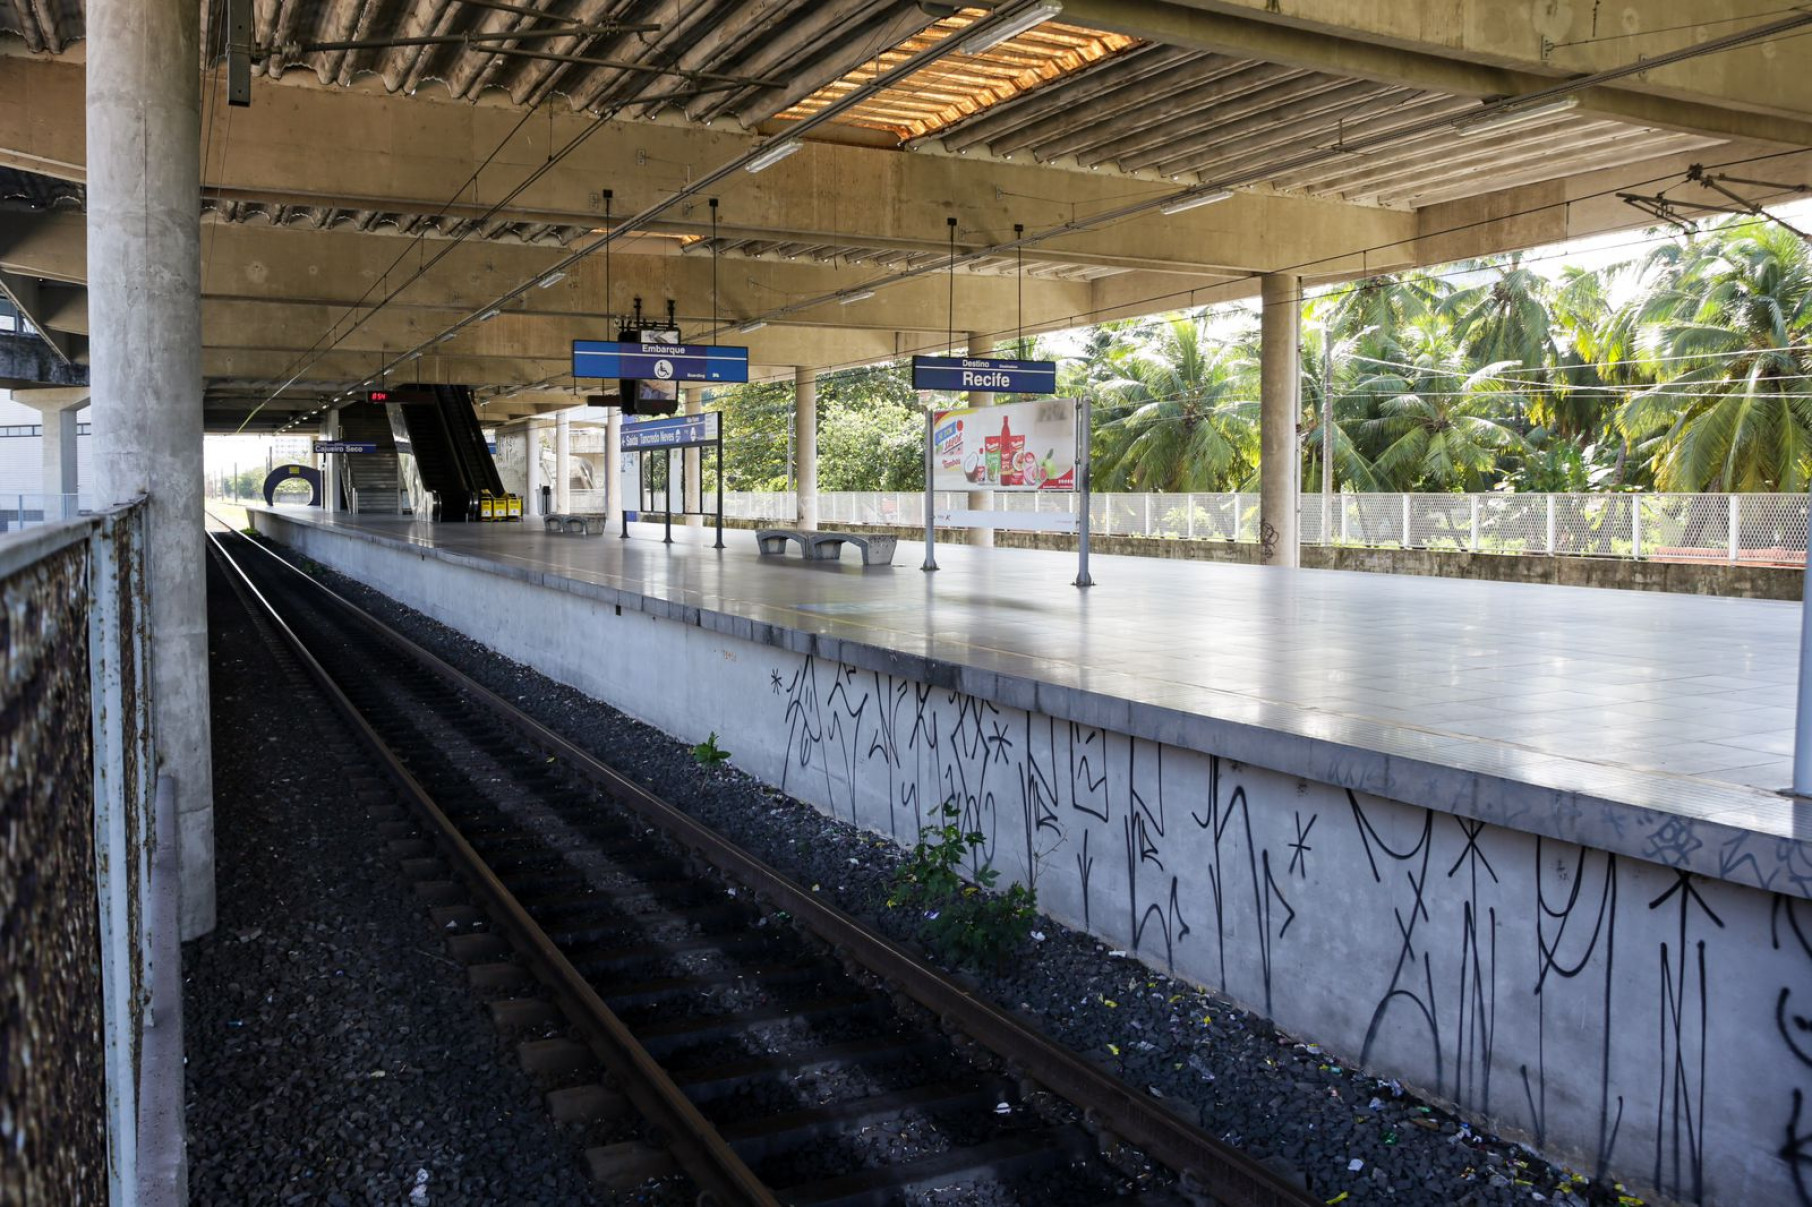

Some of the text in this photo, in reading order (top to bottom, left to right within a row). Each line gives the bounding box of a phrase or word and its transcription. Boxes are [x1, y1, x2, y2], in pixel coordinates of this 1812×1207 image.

[641, 344, 686, 355] Embarque
[962, 359, 990, 368] Destino
[962, 371, 1010, 387] Recife
[660, 430, 675, 441] Neves
[315, 445, 344, 453] Cajueiro
